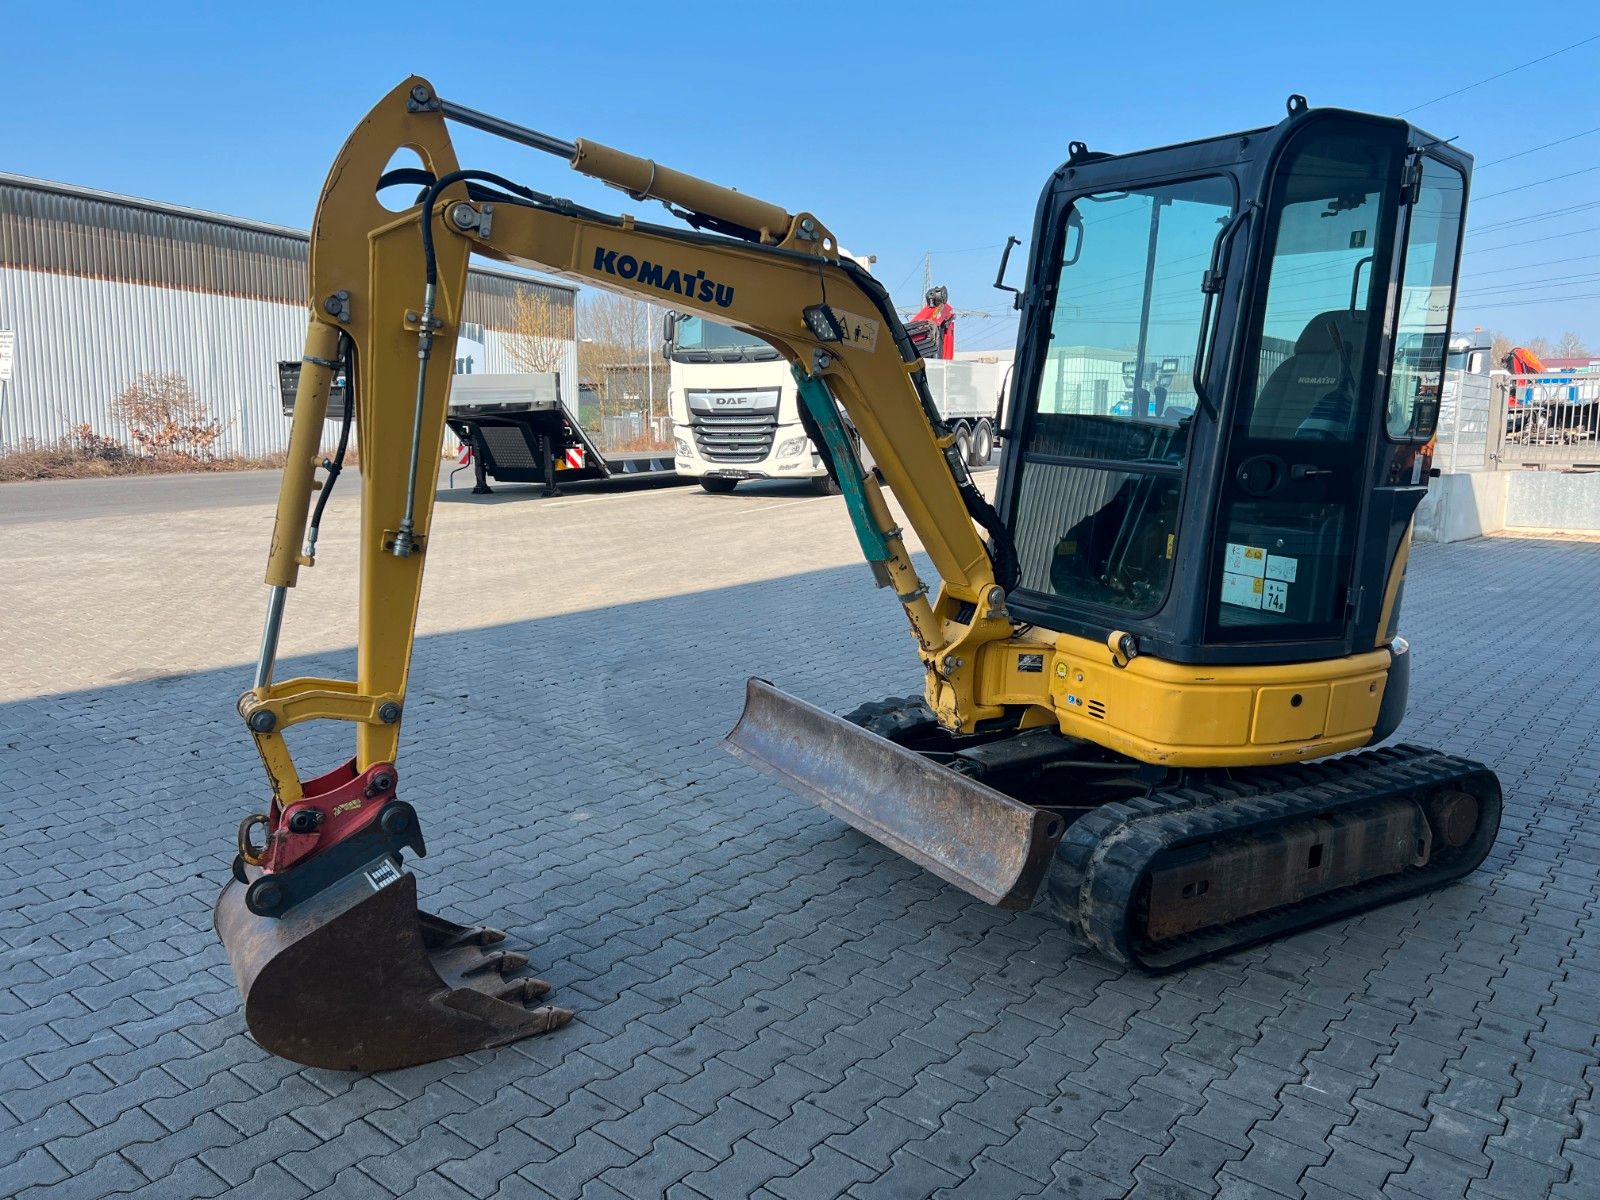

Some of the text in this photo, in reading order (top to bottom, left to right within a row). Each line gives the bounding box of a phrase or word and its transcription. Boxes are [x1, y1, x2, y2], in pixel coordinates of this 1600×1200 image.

[593, 246, 735, 308] KOMATSU
[1297, 376, 1336, 384] KOMATSU
[715, 397, 748, 405] DAF
[1268, 592, 1280, 609] 74
